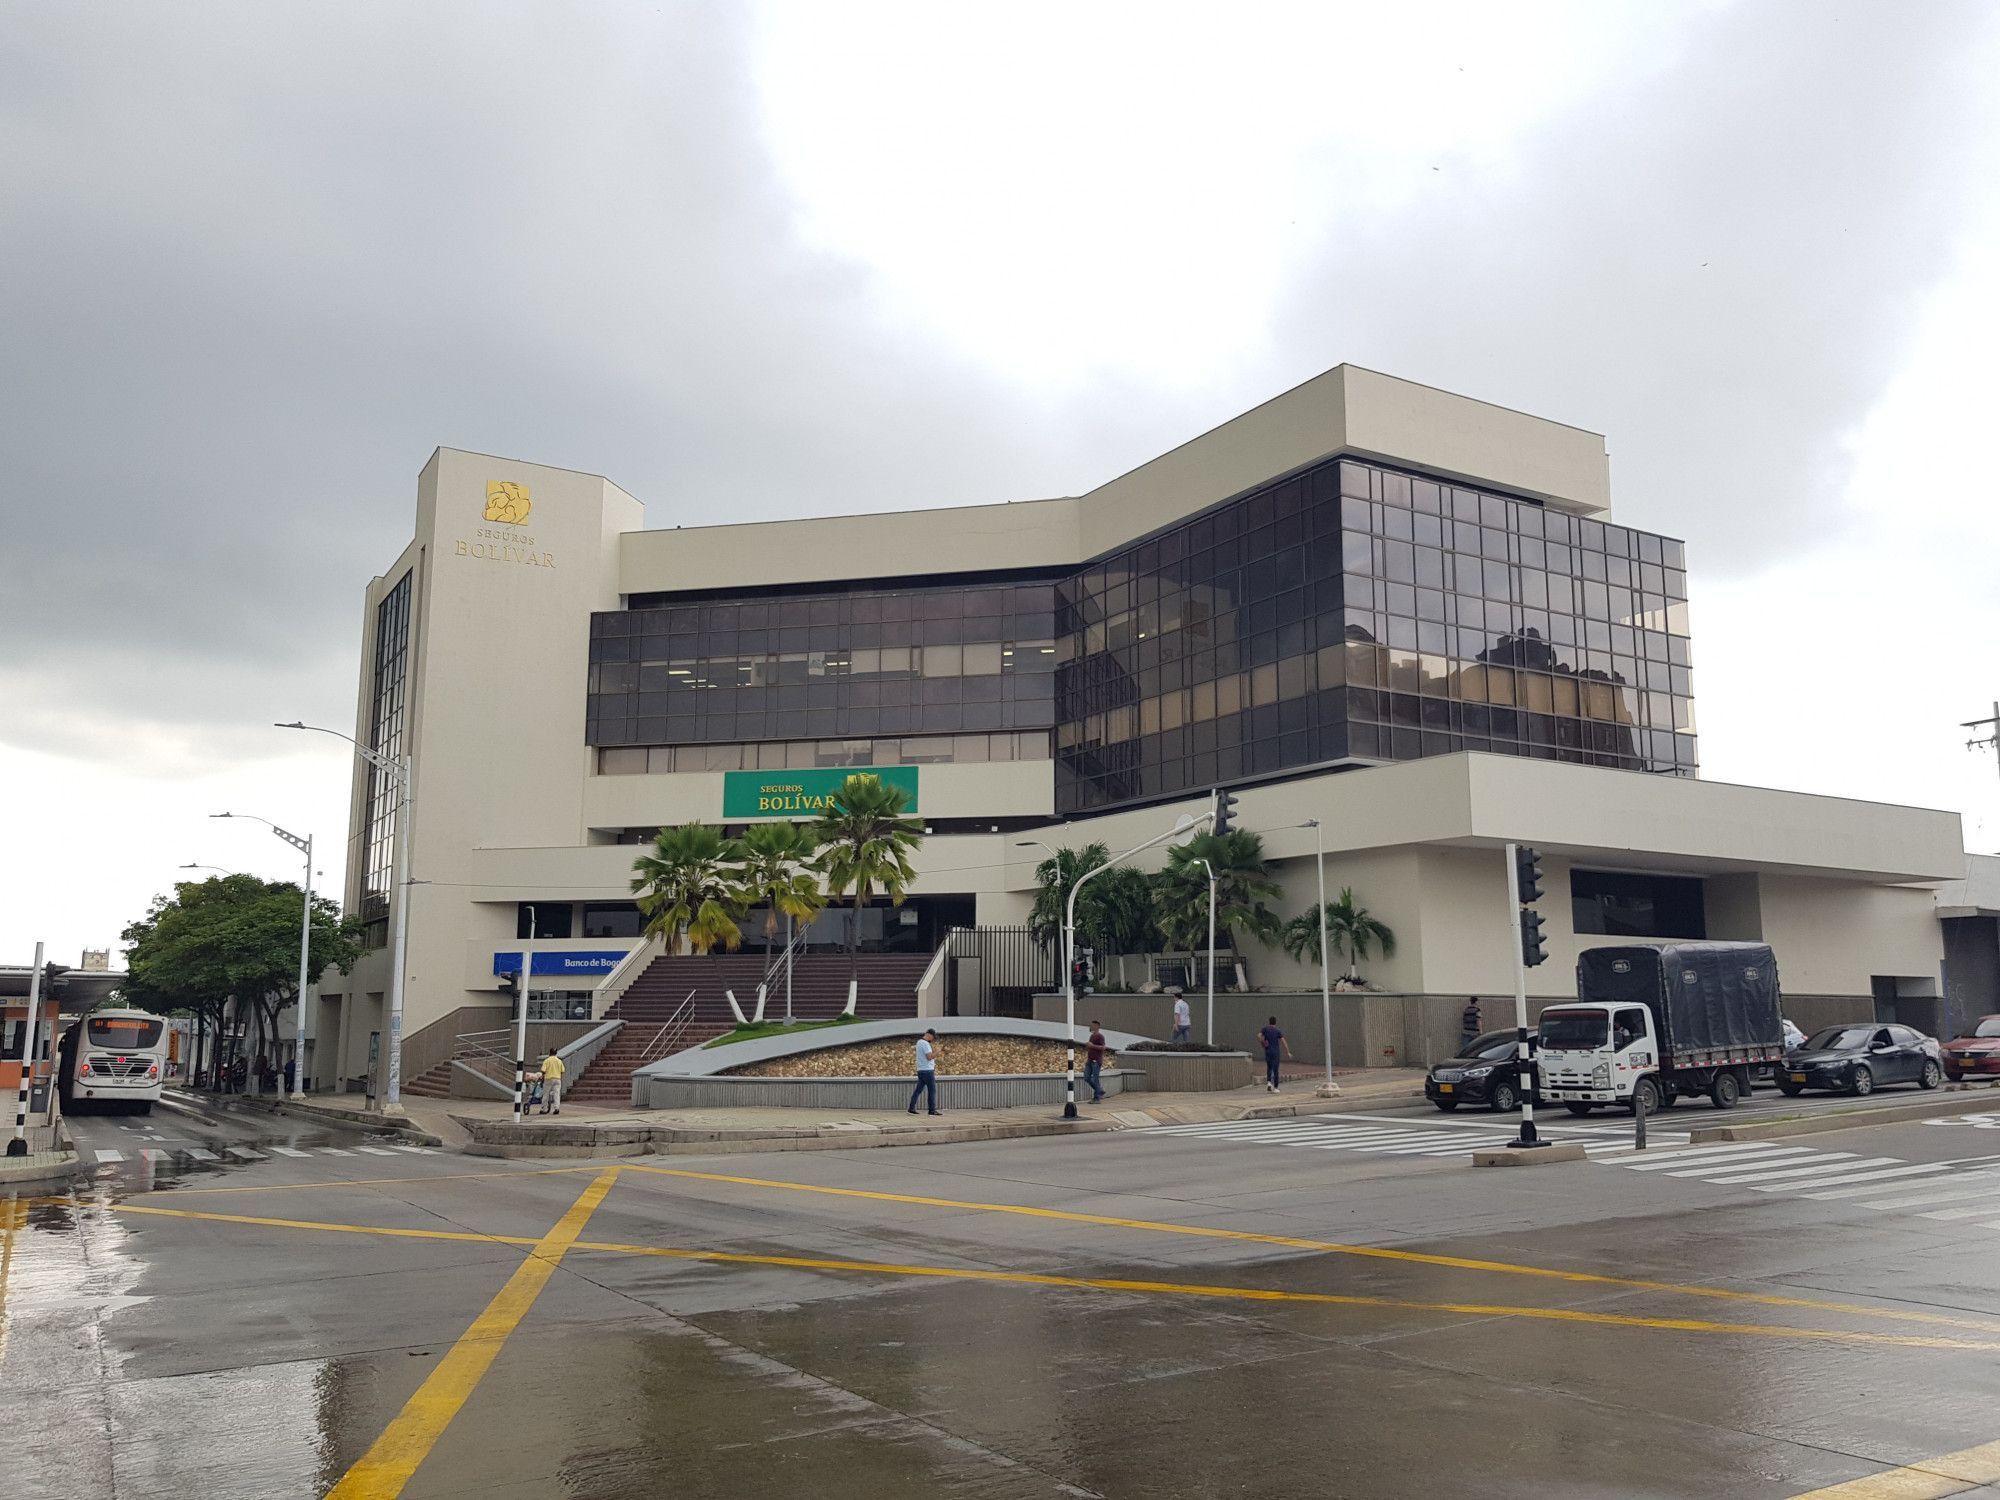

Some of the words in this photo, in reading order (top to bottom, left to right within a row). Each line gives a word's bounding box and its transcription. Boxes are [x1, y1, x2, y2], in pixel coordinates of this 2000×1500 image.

[477, 528, 536, 545] SEGUROS
[760, 785, 803, 793] SEGUROS
[759, 793, 836, 810] BOLÍVAR
[565, 958, 589, 967] Banco
[590, 958, 600, 967] de
